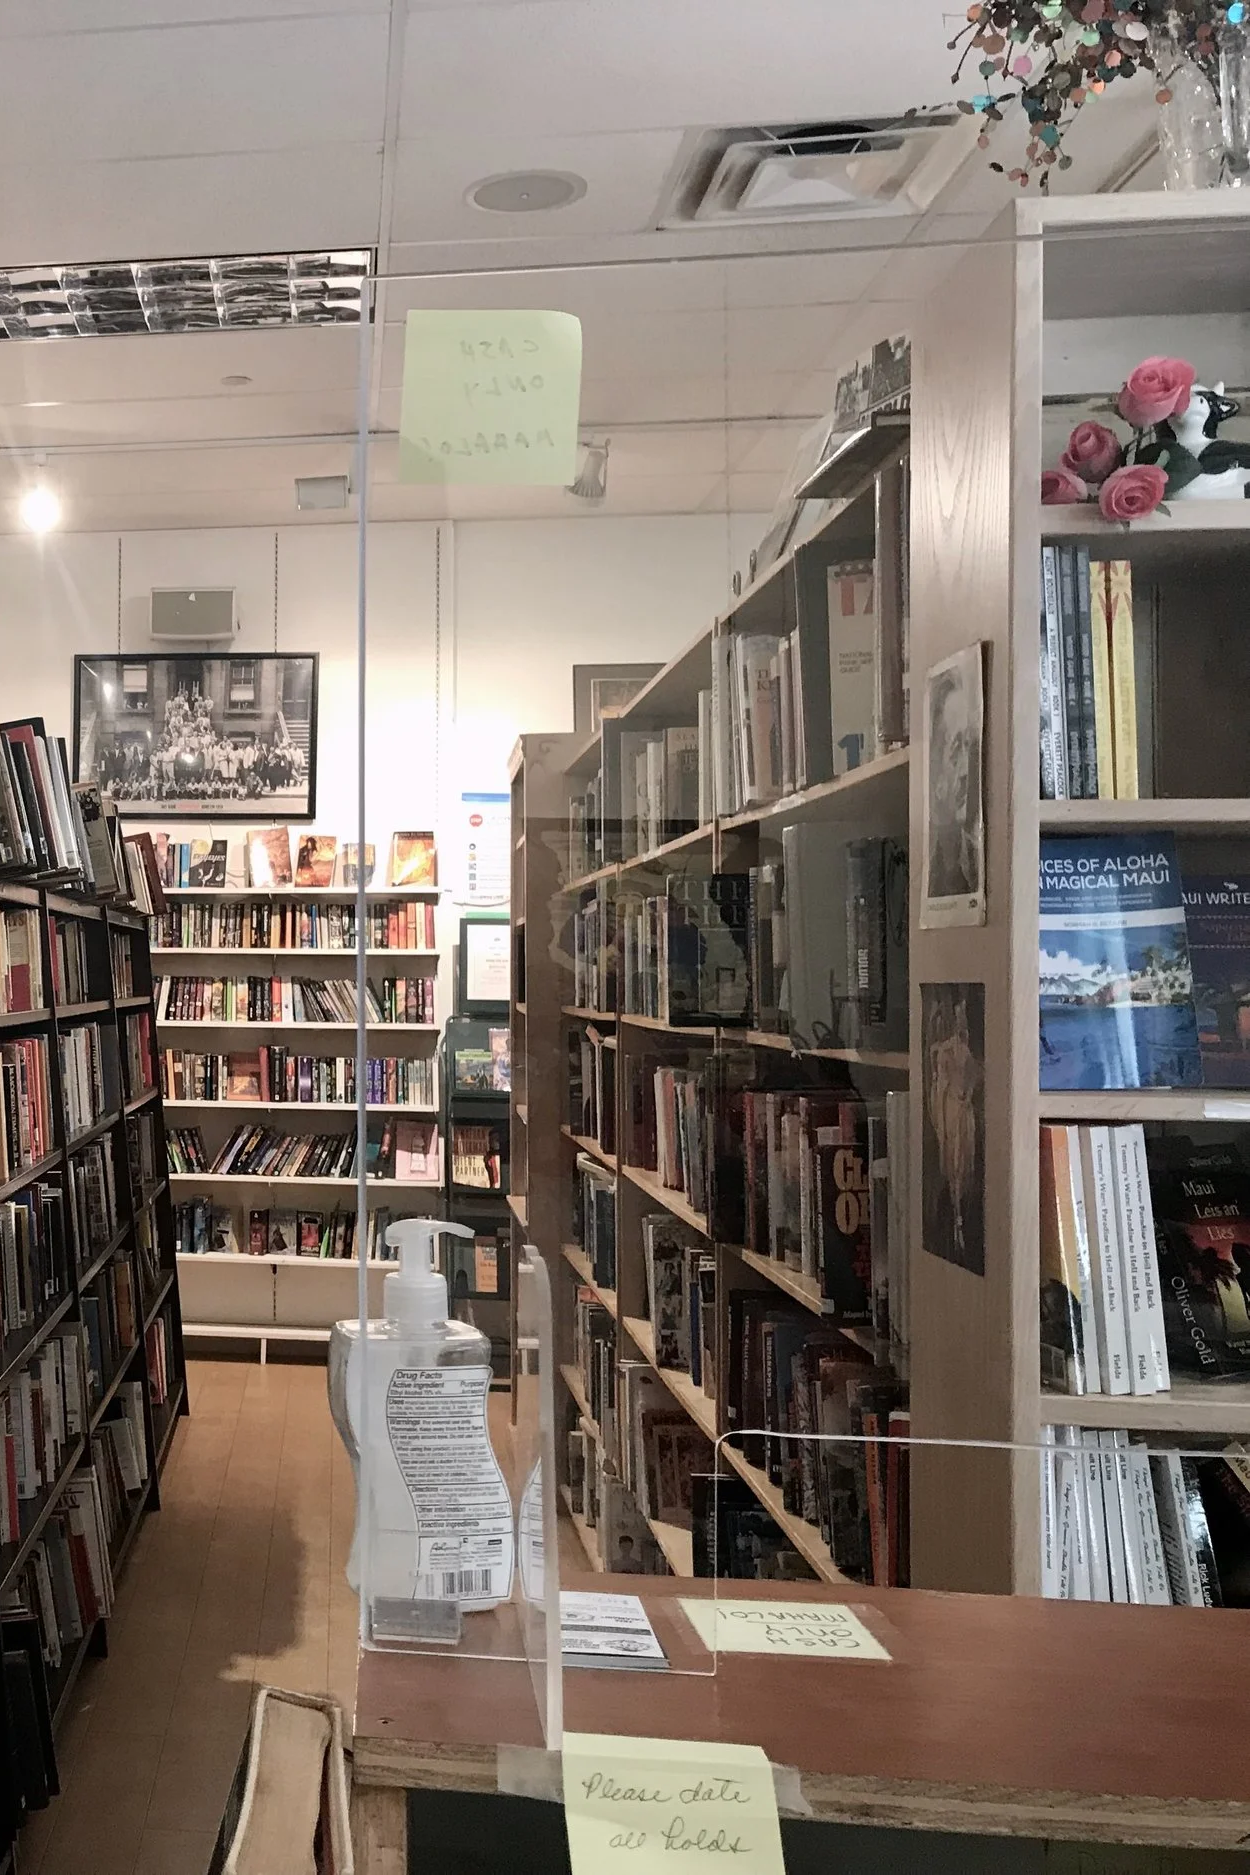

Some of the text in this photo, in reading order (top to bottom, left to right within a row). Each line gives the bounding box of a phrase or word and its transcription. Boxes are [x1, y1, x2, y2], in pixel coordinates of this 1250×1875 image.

[1039, 853, 1169, 874] ICES OF ALOHA
[1046, 870, 1171, 890] MAGICAL MAUI
[1181, 892, 1201, 905] AUI
[455, 1166, 486, 1177] PARTNER
[1182, 1179, 1216, 1198] Maui
[1194, 1203, 1214, 1219] Leis
[1208, 1225, 1235, 1241] Lies
[1171, 1275, 1216, 1365] Oliver Gold
[396, 1371, 443, 1380] Drug Facts
[1138, 1354, 1146, 1380] Fields
[446, 1520, 479, 1528] ingredients
[1199, 1562, 1209, 1583] Rick
[718, 1607, 849, 1624] MAHALO!
[765, 1623, 853, 1639] ONLY
[766, 1635, 861, 1649] CASH
[582, 1773, 753, 1805] Please date
[608, 1816, 754, 1853] all holds
